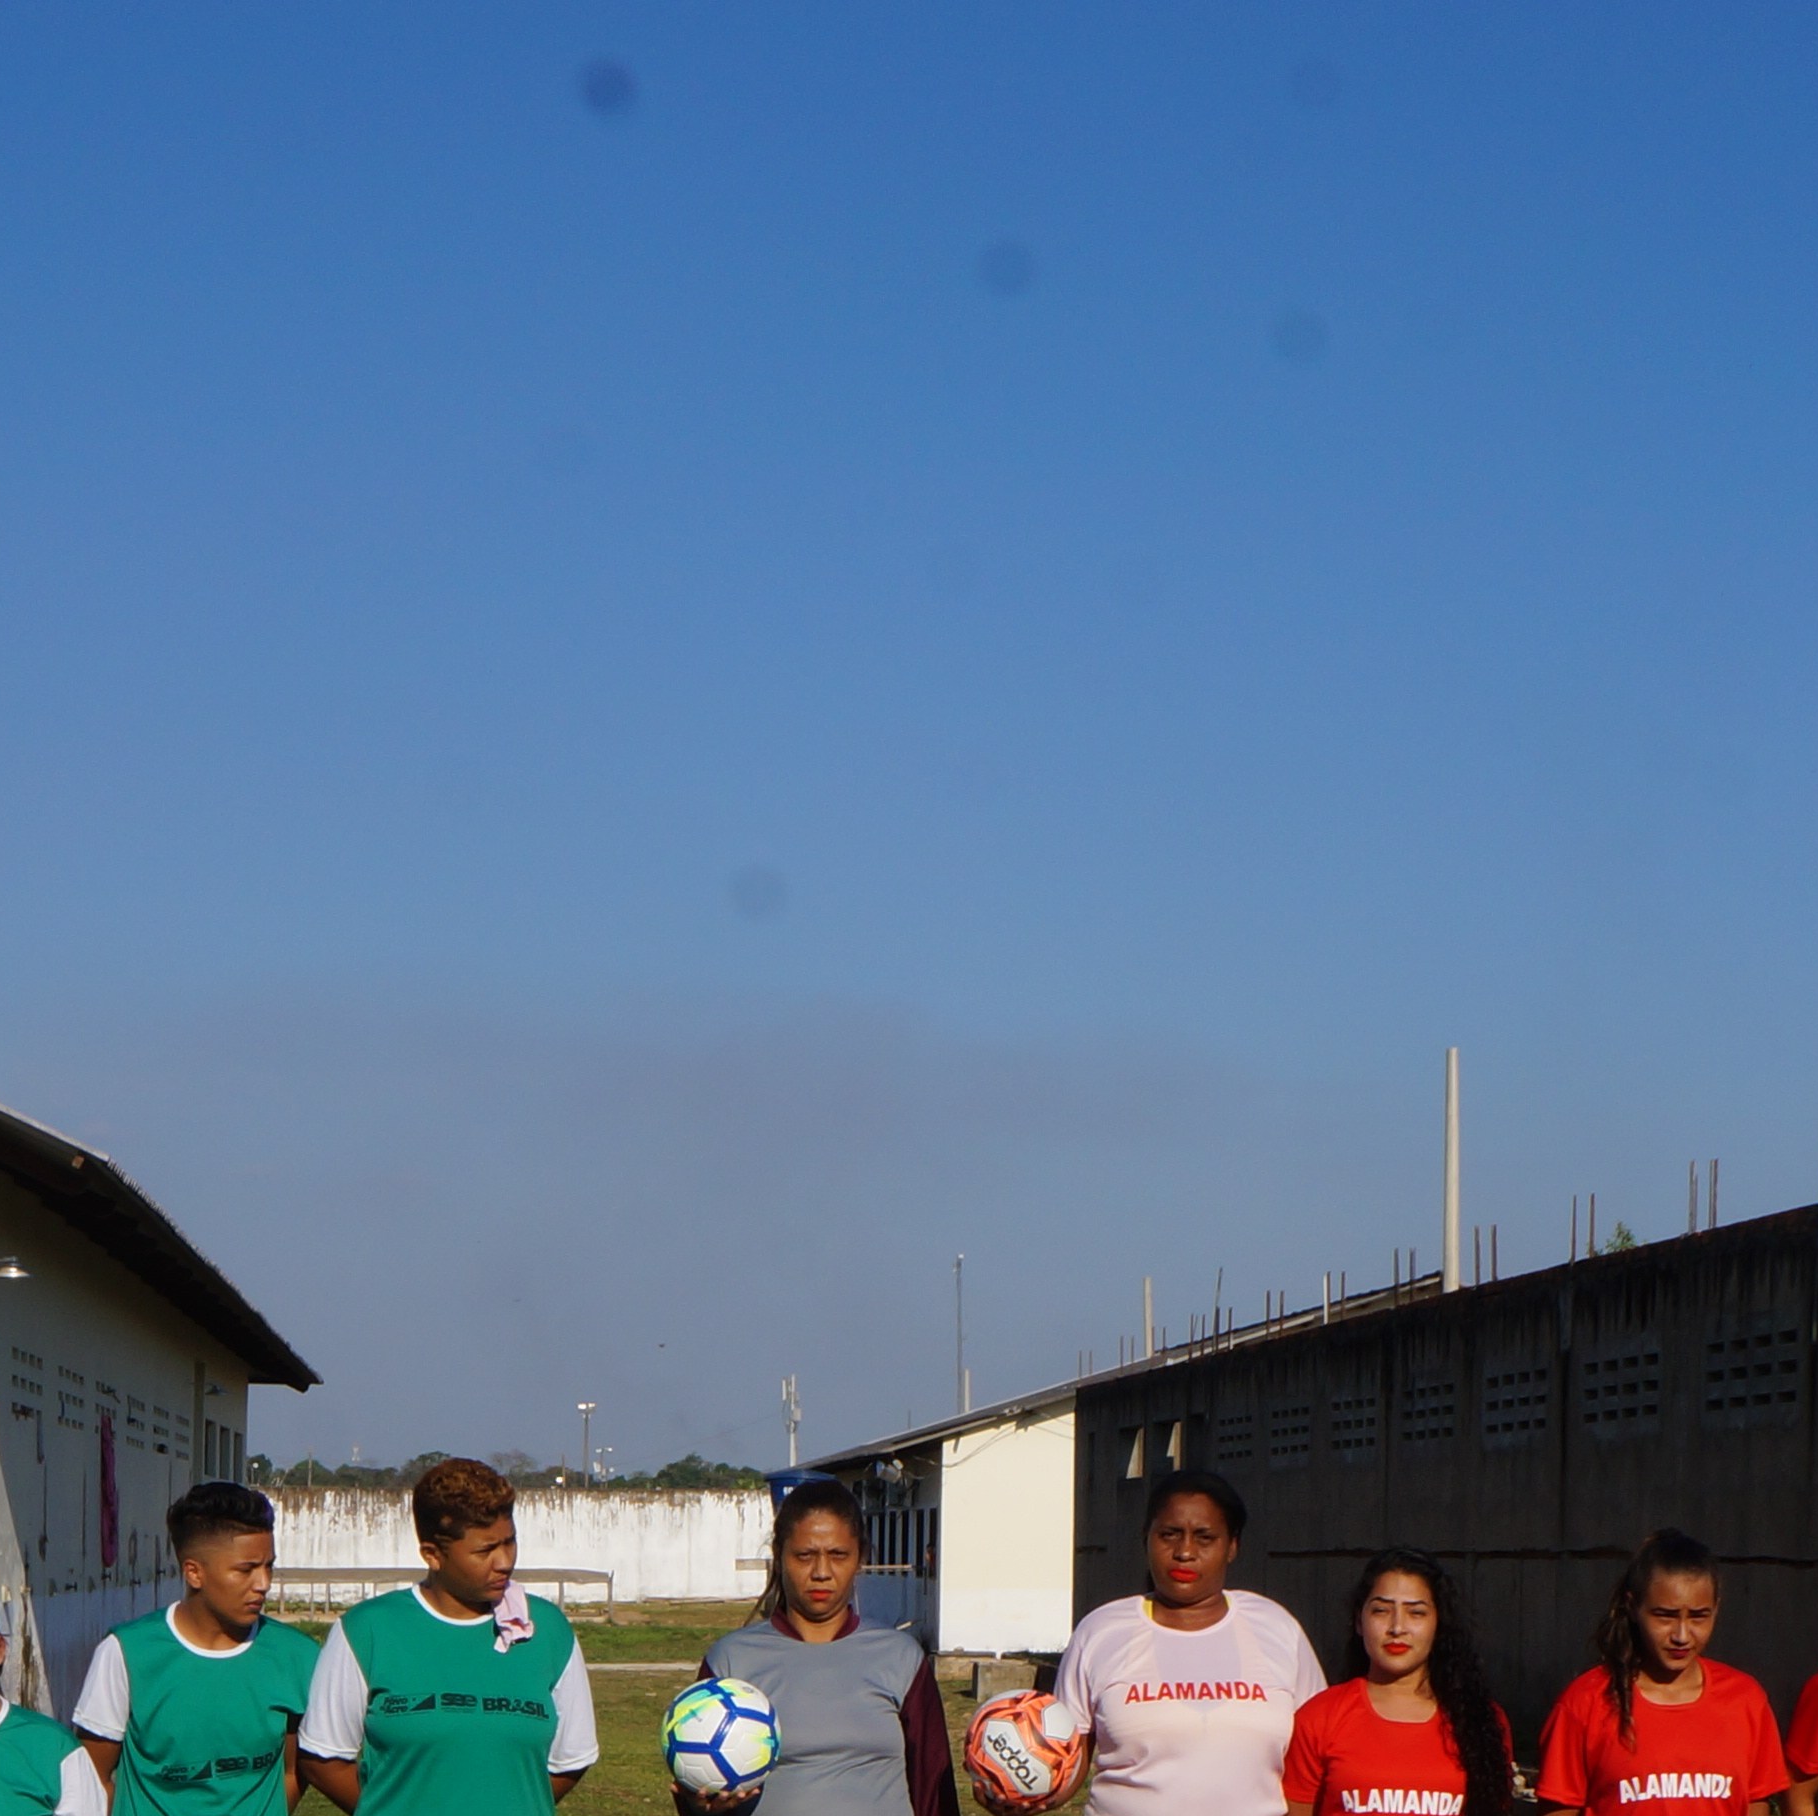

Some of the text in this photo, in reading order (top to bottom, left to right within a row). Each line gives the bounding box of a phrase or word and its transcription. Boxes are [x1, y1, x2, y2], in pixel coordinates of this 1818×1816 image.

[1125, 1681, 1267, 1705] ALAMANDA
[482, 1697, 550, 1719] BRASIL
[987, 1733, 1038, 1790] Topper
